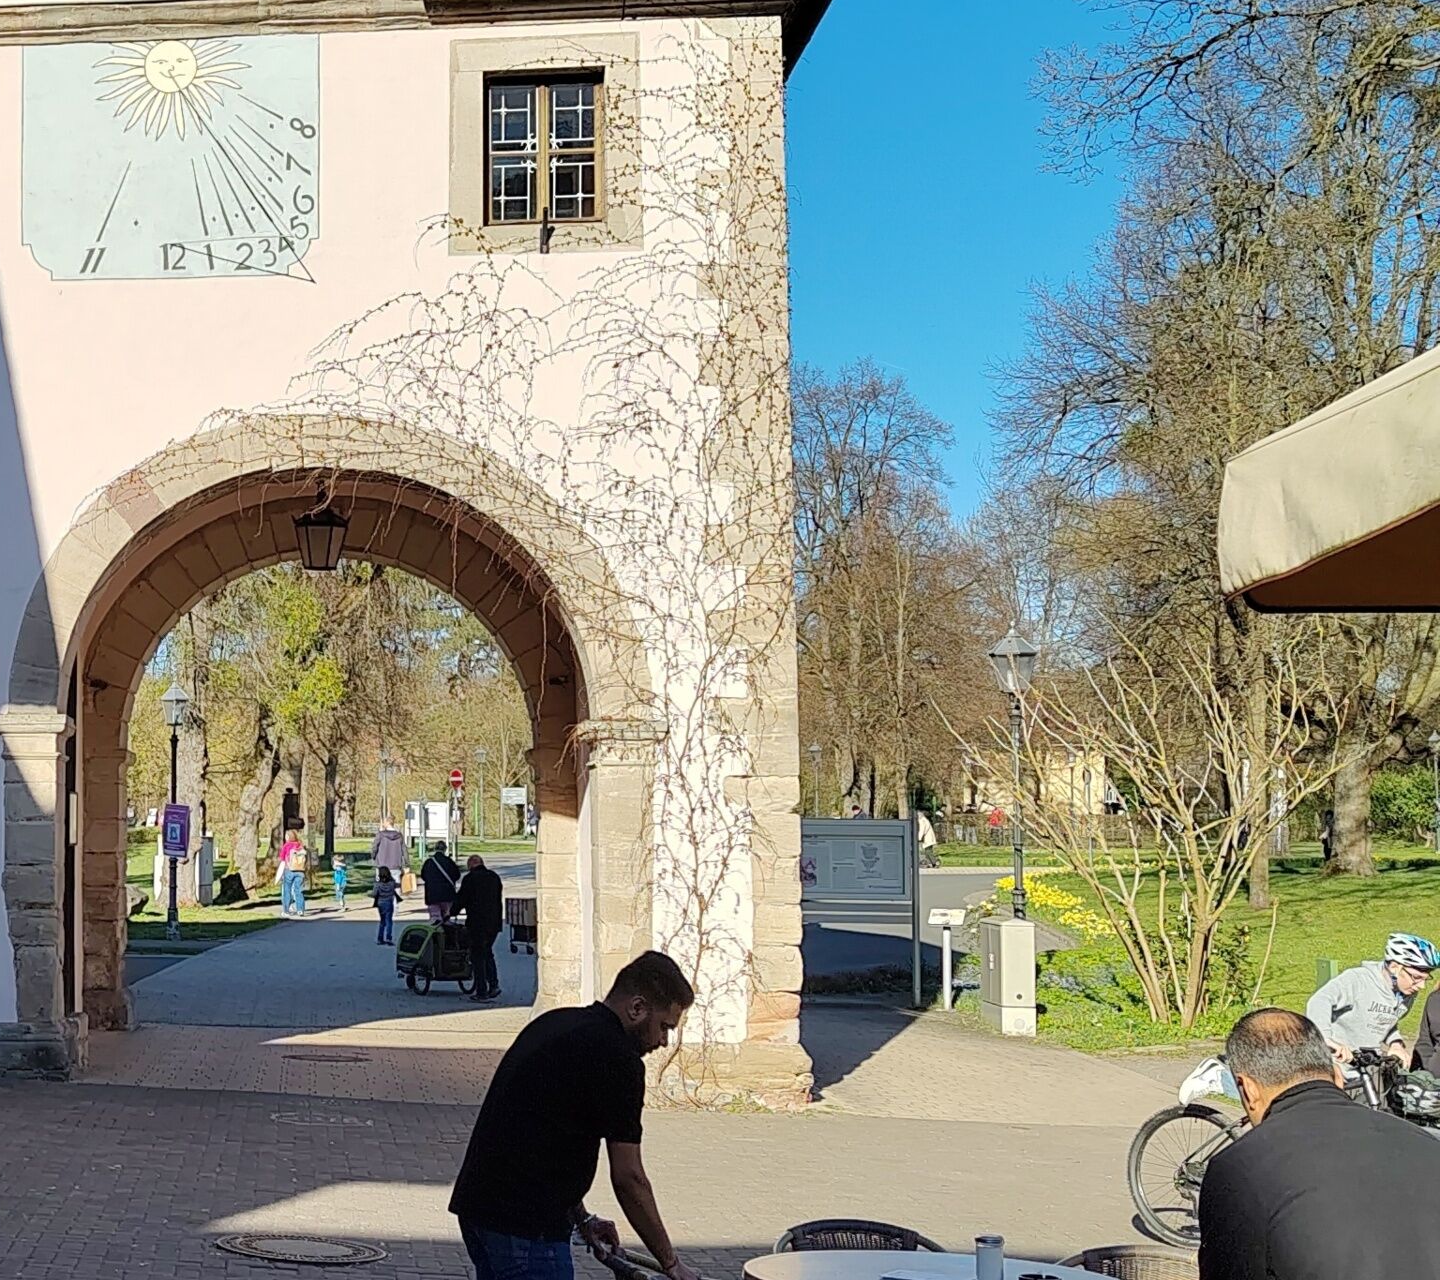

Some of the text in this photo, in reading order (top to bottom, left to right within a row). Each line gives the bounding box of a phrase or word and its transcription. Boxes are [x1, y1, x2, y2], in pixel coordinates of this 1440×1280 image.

[289, 117, 316, 139] 8
[285, 151, 312, 176] 7
[292, 184, 315, 214] 6
[290, 215, 309, 239] 5
[79, 247, 107, 274] 11
[160, 242, 187, 270] 12
[203, 242, 215, 270] 1
[234, 242, 254, 270] 2
[257, 238, 278, 267] 3
